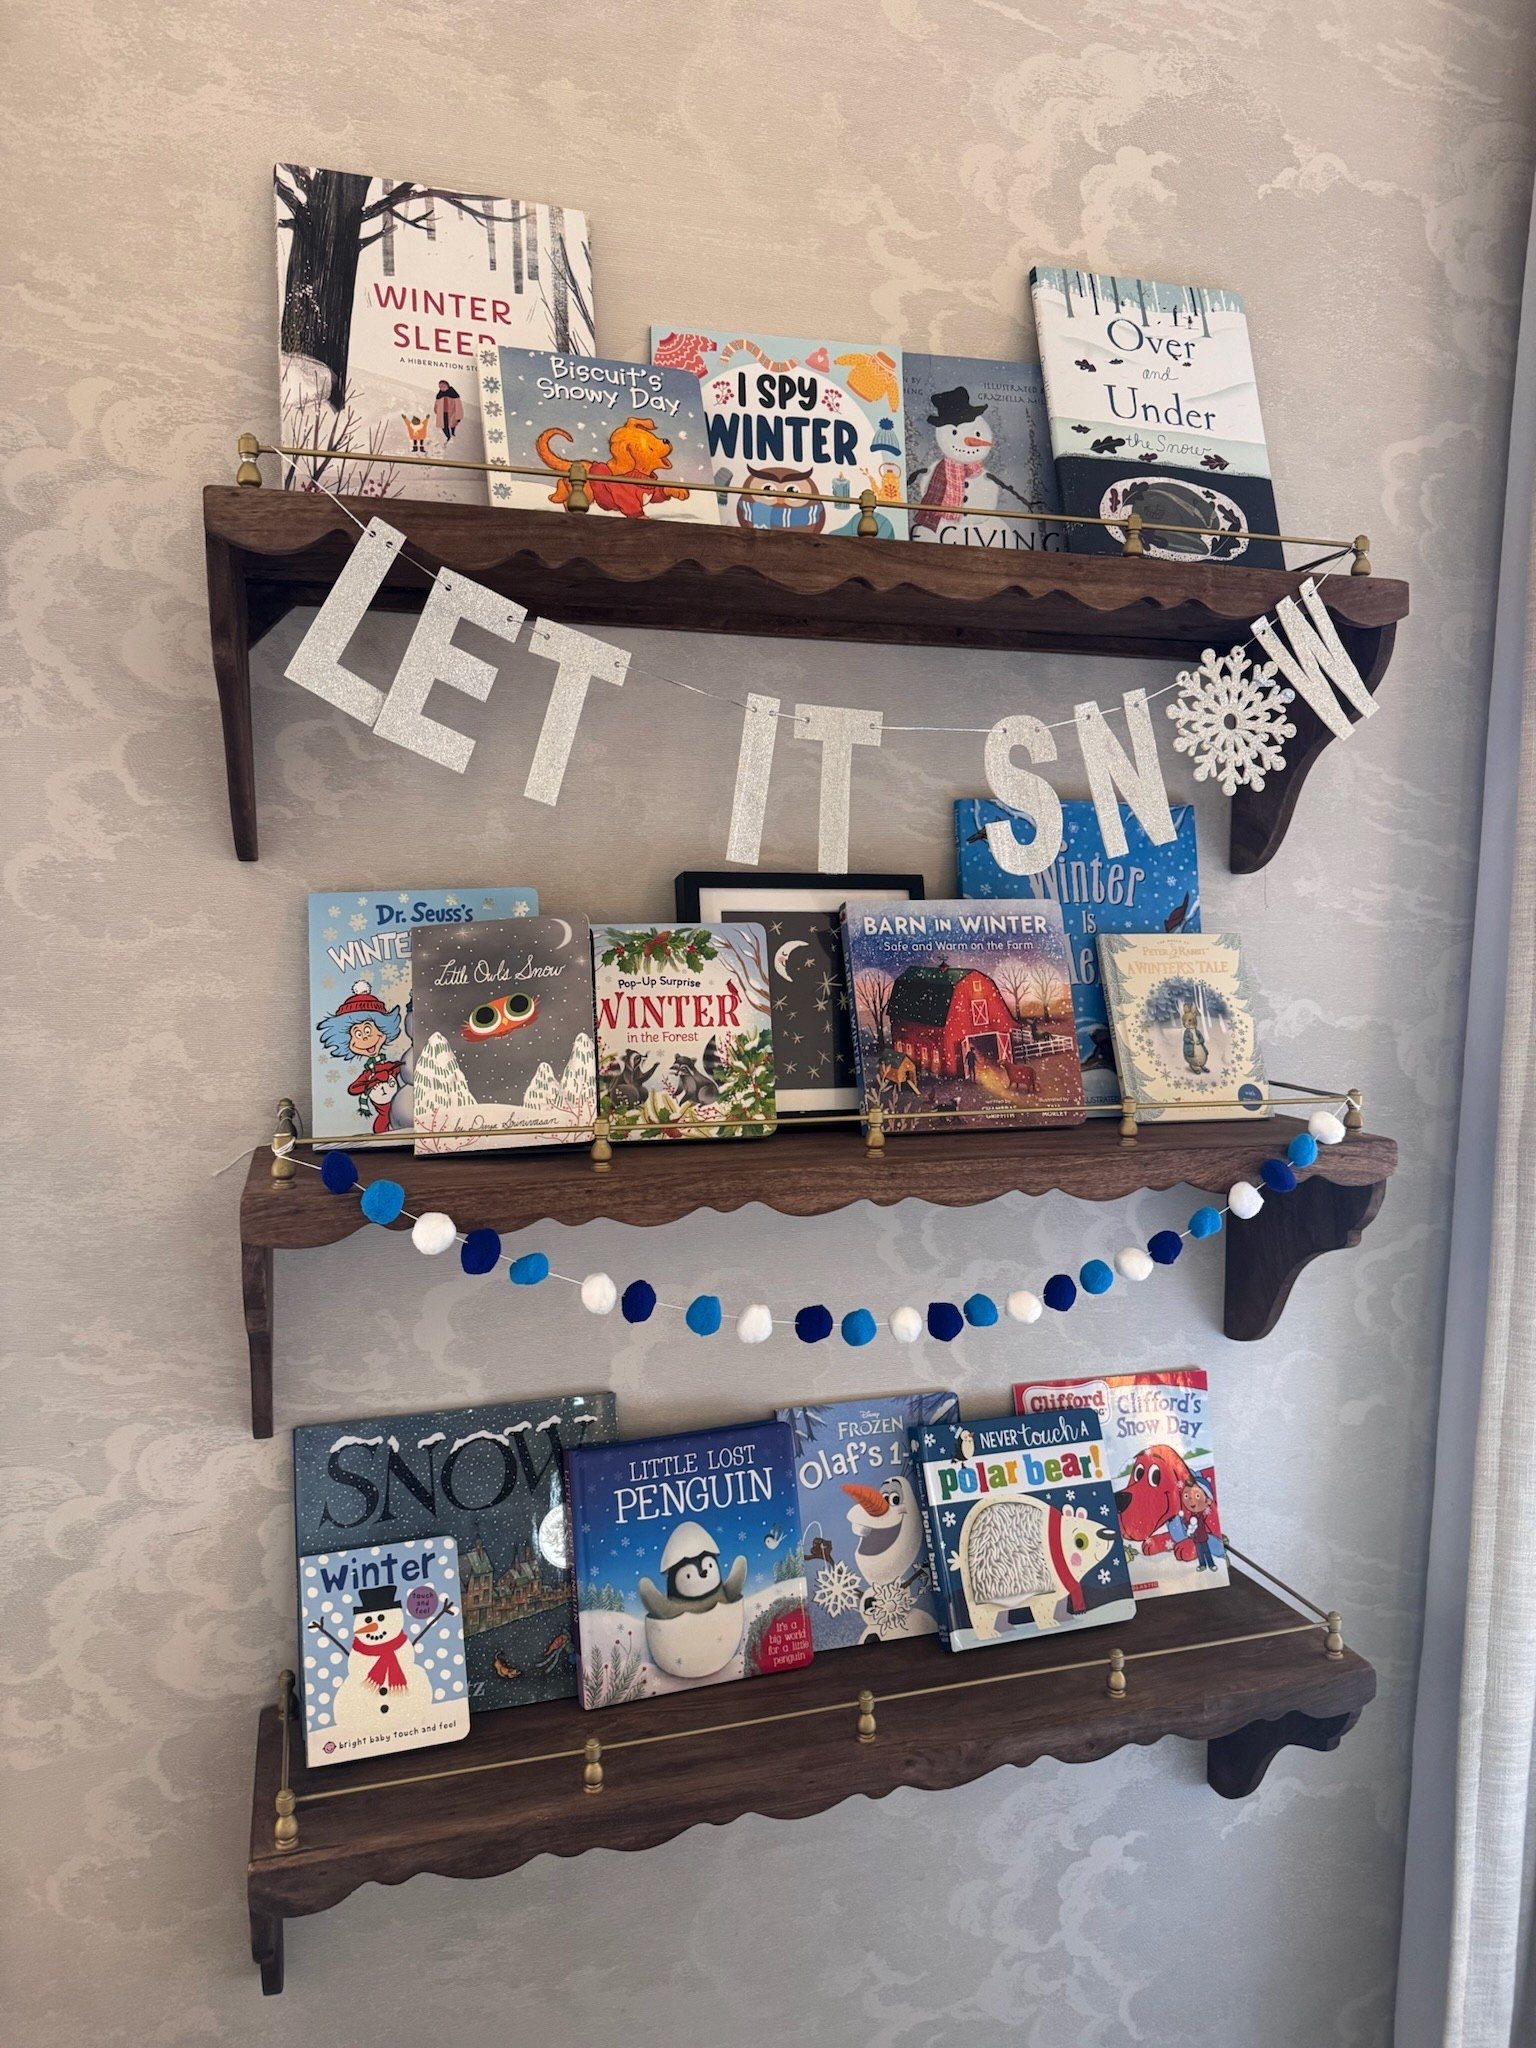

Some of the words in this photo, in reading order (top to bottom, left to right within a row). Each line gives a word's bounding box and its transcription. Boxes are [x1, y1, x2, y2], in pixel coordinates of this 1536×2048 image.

[374, 283, 512, 325] WINTER
[1107, 319, 1195, 359] Over
[408, 358, 464, 370] HIBERNATION
[550, 356, 663, 392] Biscuit's
[1142, 367, 1178, 381] and
[536, 377, 619, 409] Snowy
[629, 387, 680, 417] Day
[738, 371, 747, 408] I
[756, 373, 818, 411] SPY
[984, 382, 1038, 394] ILLUSTRATED
[1103, 384, 1216, 431] Under
[704, 412, 858, 466] WINTER
[1125, 433, 1153, 451] the
[1155, 434, 1212, 456] Snow
[939, 525, 1061, 552] GIVING
[283, 515, 632, 807] LET
[725, 691, 884, 875] IT
[375, 903, 407, 926] Dr.
[410, 901, 474, 923] Seuss's
[863, 916, 927, 936] BARN
[958, 915, 1048, 934] WINTER
[326, 931, 412, 974] WINTE
[883, 941, 908, 952] Safe
[912, 940, 932, 951] and
[934, 940, 968, 951] Warm
[971, 942, 984, 951] on
[987, 940, 1003, 950] the
[1007, 940, 1034, 950] Farm
[434, 958, 470, 986] Little
[514, 954, 567, 980] Snow
[1127, 964, 1135, 975] A
[1135, 961, 1194, 975] WINTER'S
[1195, 961, 1229, 974] TALE
[618, 976, 657, 990] Pop-Up
[660, 976, 701, 989] Surprise
[597, 991, 741, 1030] WINTER
[627, 1032, 638, 1043] in
[641, 1031, 660, 1043] the
[663, 1031, 699, 1042] Forest
[1030, 1390, 1106, 1412] Clifford
[1117, 1390, 1202, 1415] Clifford's
[838, 1416, 905, 1441] FROZEN
[980, 1429, 1017, 1449] NEVER
[1016, 1416, 1080, 1447] touch
[1080, 1420, 1089, 1437] A
[1117, 1416, 1159, 1438] Snow
[1167, 1416, 1203, 1439] Day
[318, 1414, 598, 1530] SNOW
[629, 1452, 698, 1483] LITTLE
[707, 1444, 756, 1470] LOST
[800, 1441, 884, 1490] Olaf's
[938, 1460, 1018, 1501] polar
[1022, 1444, 1104, 1486] bear!
[614, 1467, 773, 1524] PENGUIN
[769, 1634, 782, 1645] big
[784, 1629, 806, 1641] world
[776, 1622, 788, 1632] It's
[791, 1622, 797, 1630] a
[768, 1645, 779, 1655] for
[792, 1640, 809, 1651] little
[773, 1651, 806, 1667] penguin
[339, 1737, 368, 1750] bright
[369, 1734, 391, 1744] baby
[393, 1728, 419, 1739] touch
[421, 1724, 437, 1734] and
[439, 1720, 457, 1730] feel
